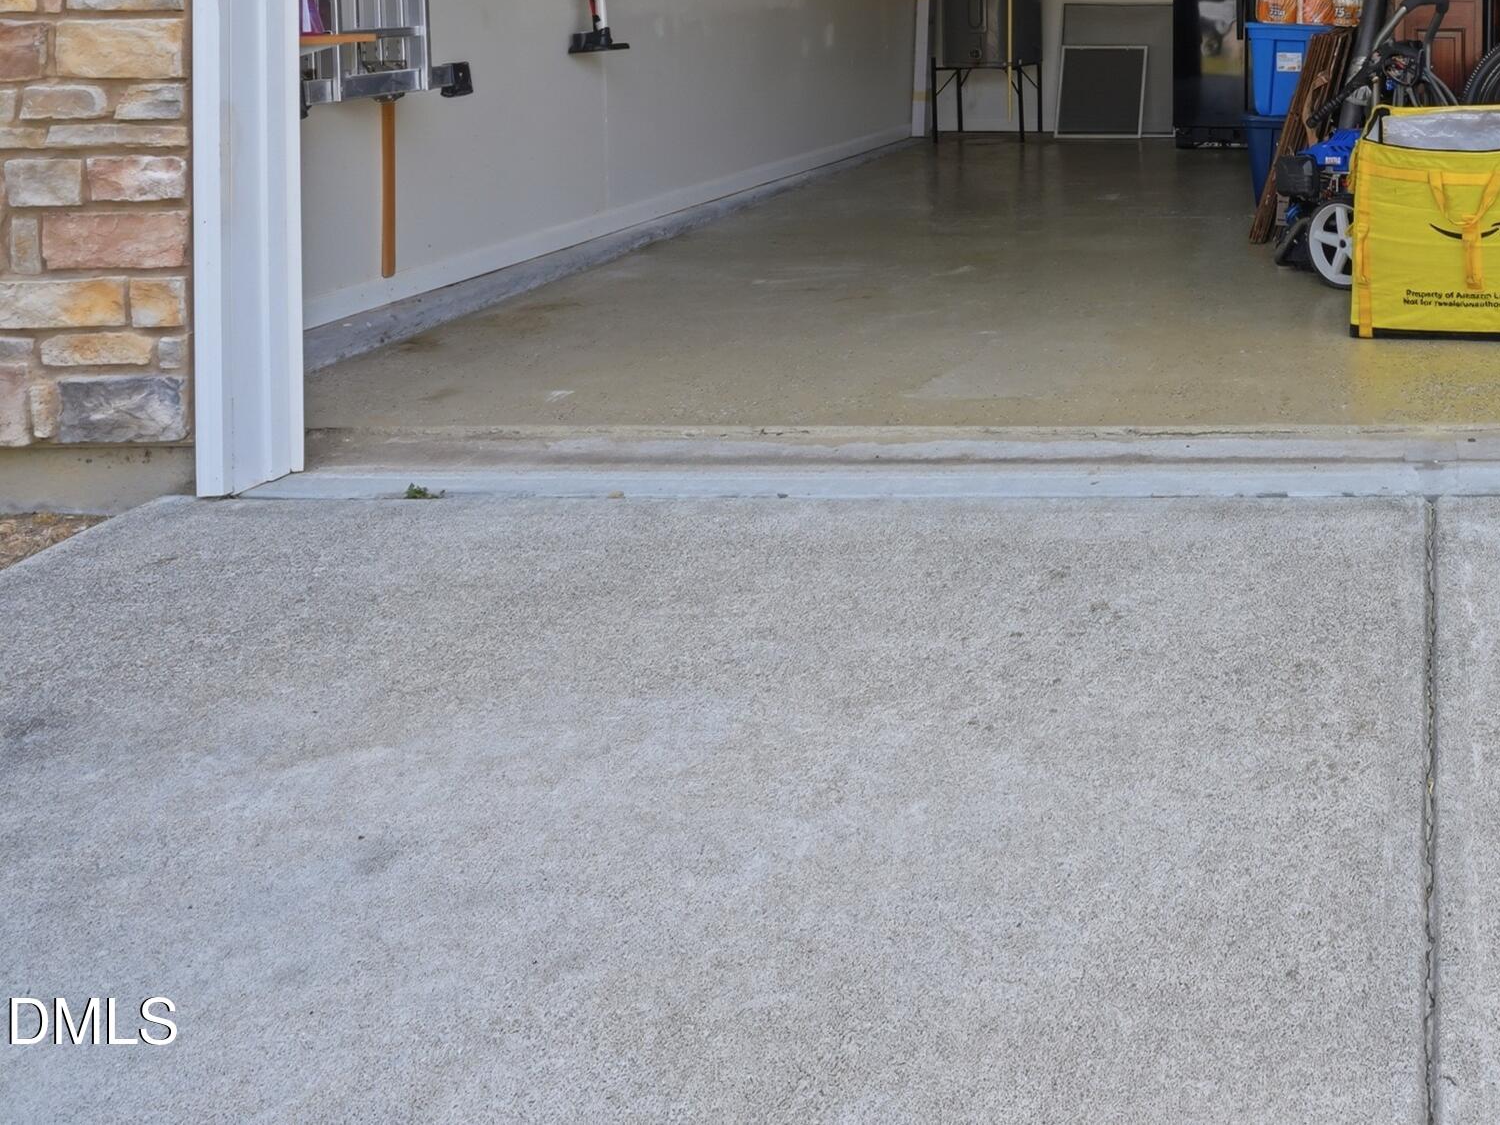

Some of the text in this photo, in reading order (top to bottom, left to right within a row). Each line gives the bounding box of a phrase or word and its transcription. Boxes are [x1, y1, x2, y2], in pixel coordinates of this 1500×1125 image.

[1406, 289, 1442, 299] Property
[1445, 291, 1454, 299] of
[1420, 298, 1432, 306] for
